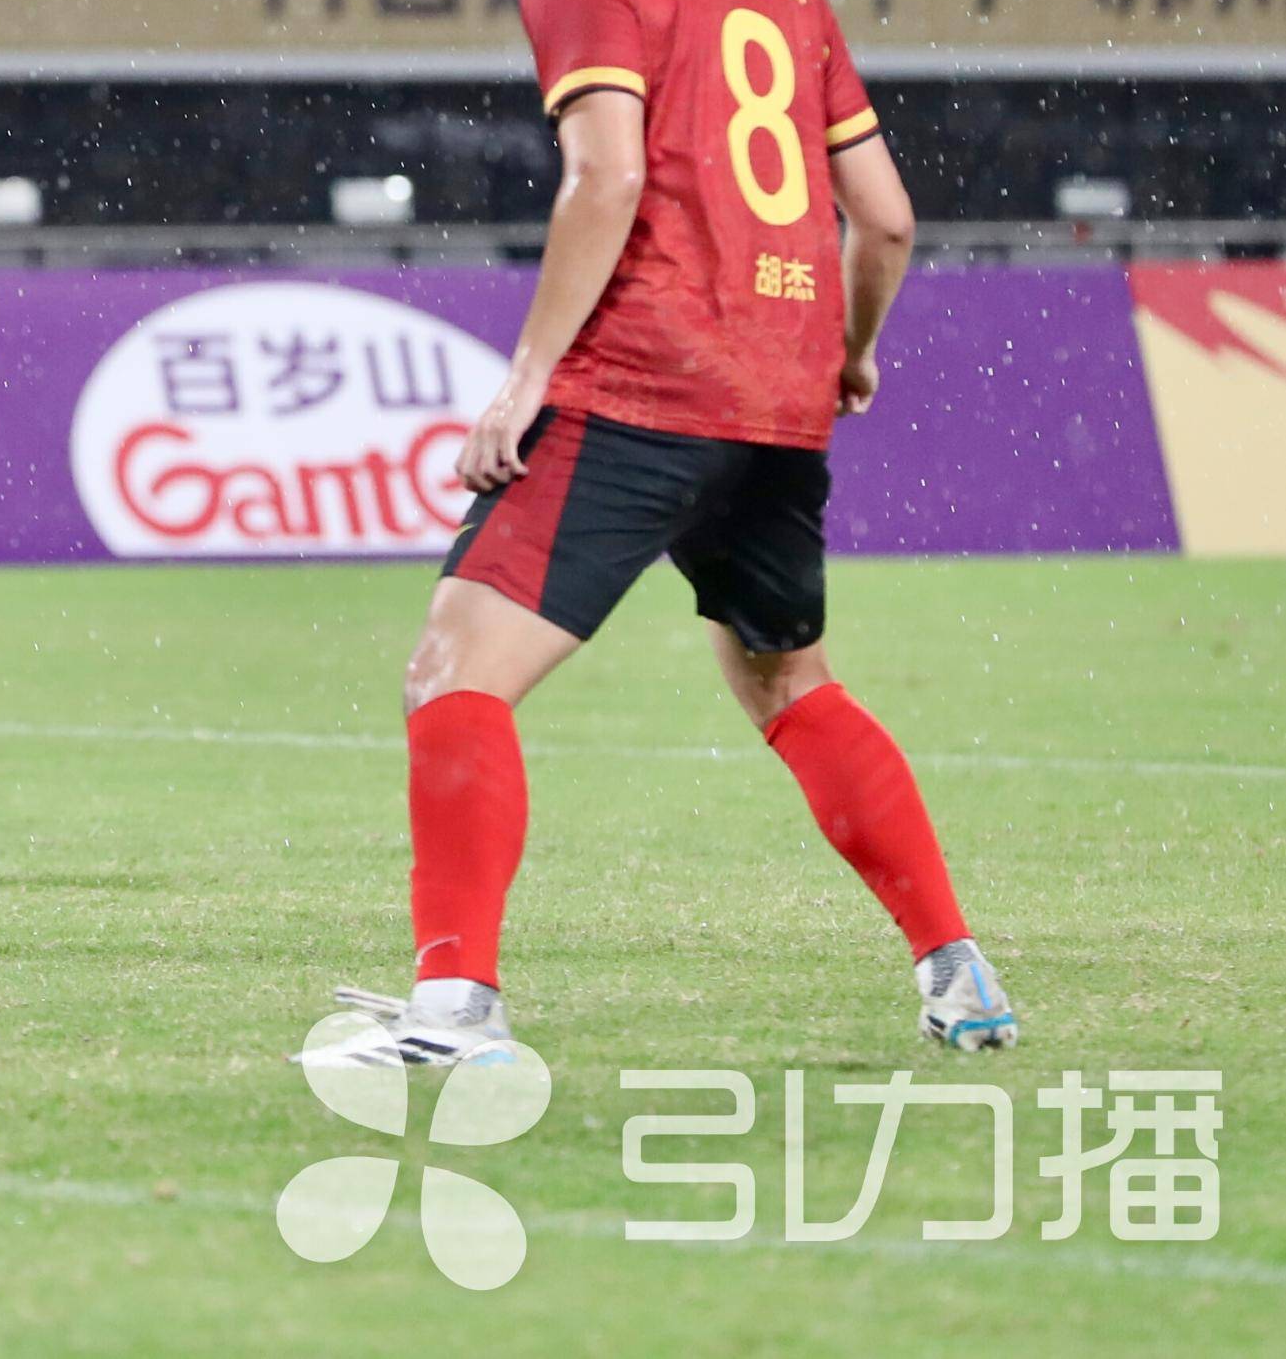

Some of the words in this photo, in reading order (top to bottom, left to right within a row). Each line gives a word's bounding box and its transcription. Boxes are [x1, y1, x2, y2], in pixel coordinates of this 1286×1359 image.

[722, 7, 810, 226] 8
[754, 252, 817, 302] 胡杰
[154, 329, 456, 416] 百岁山
